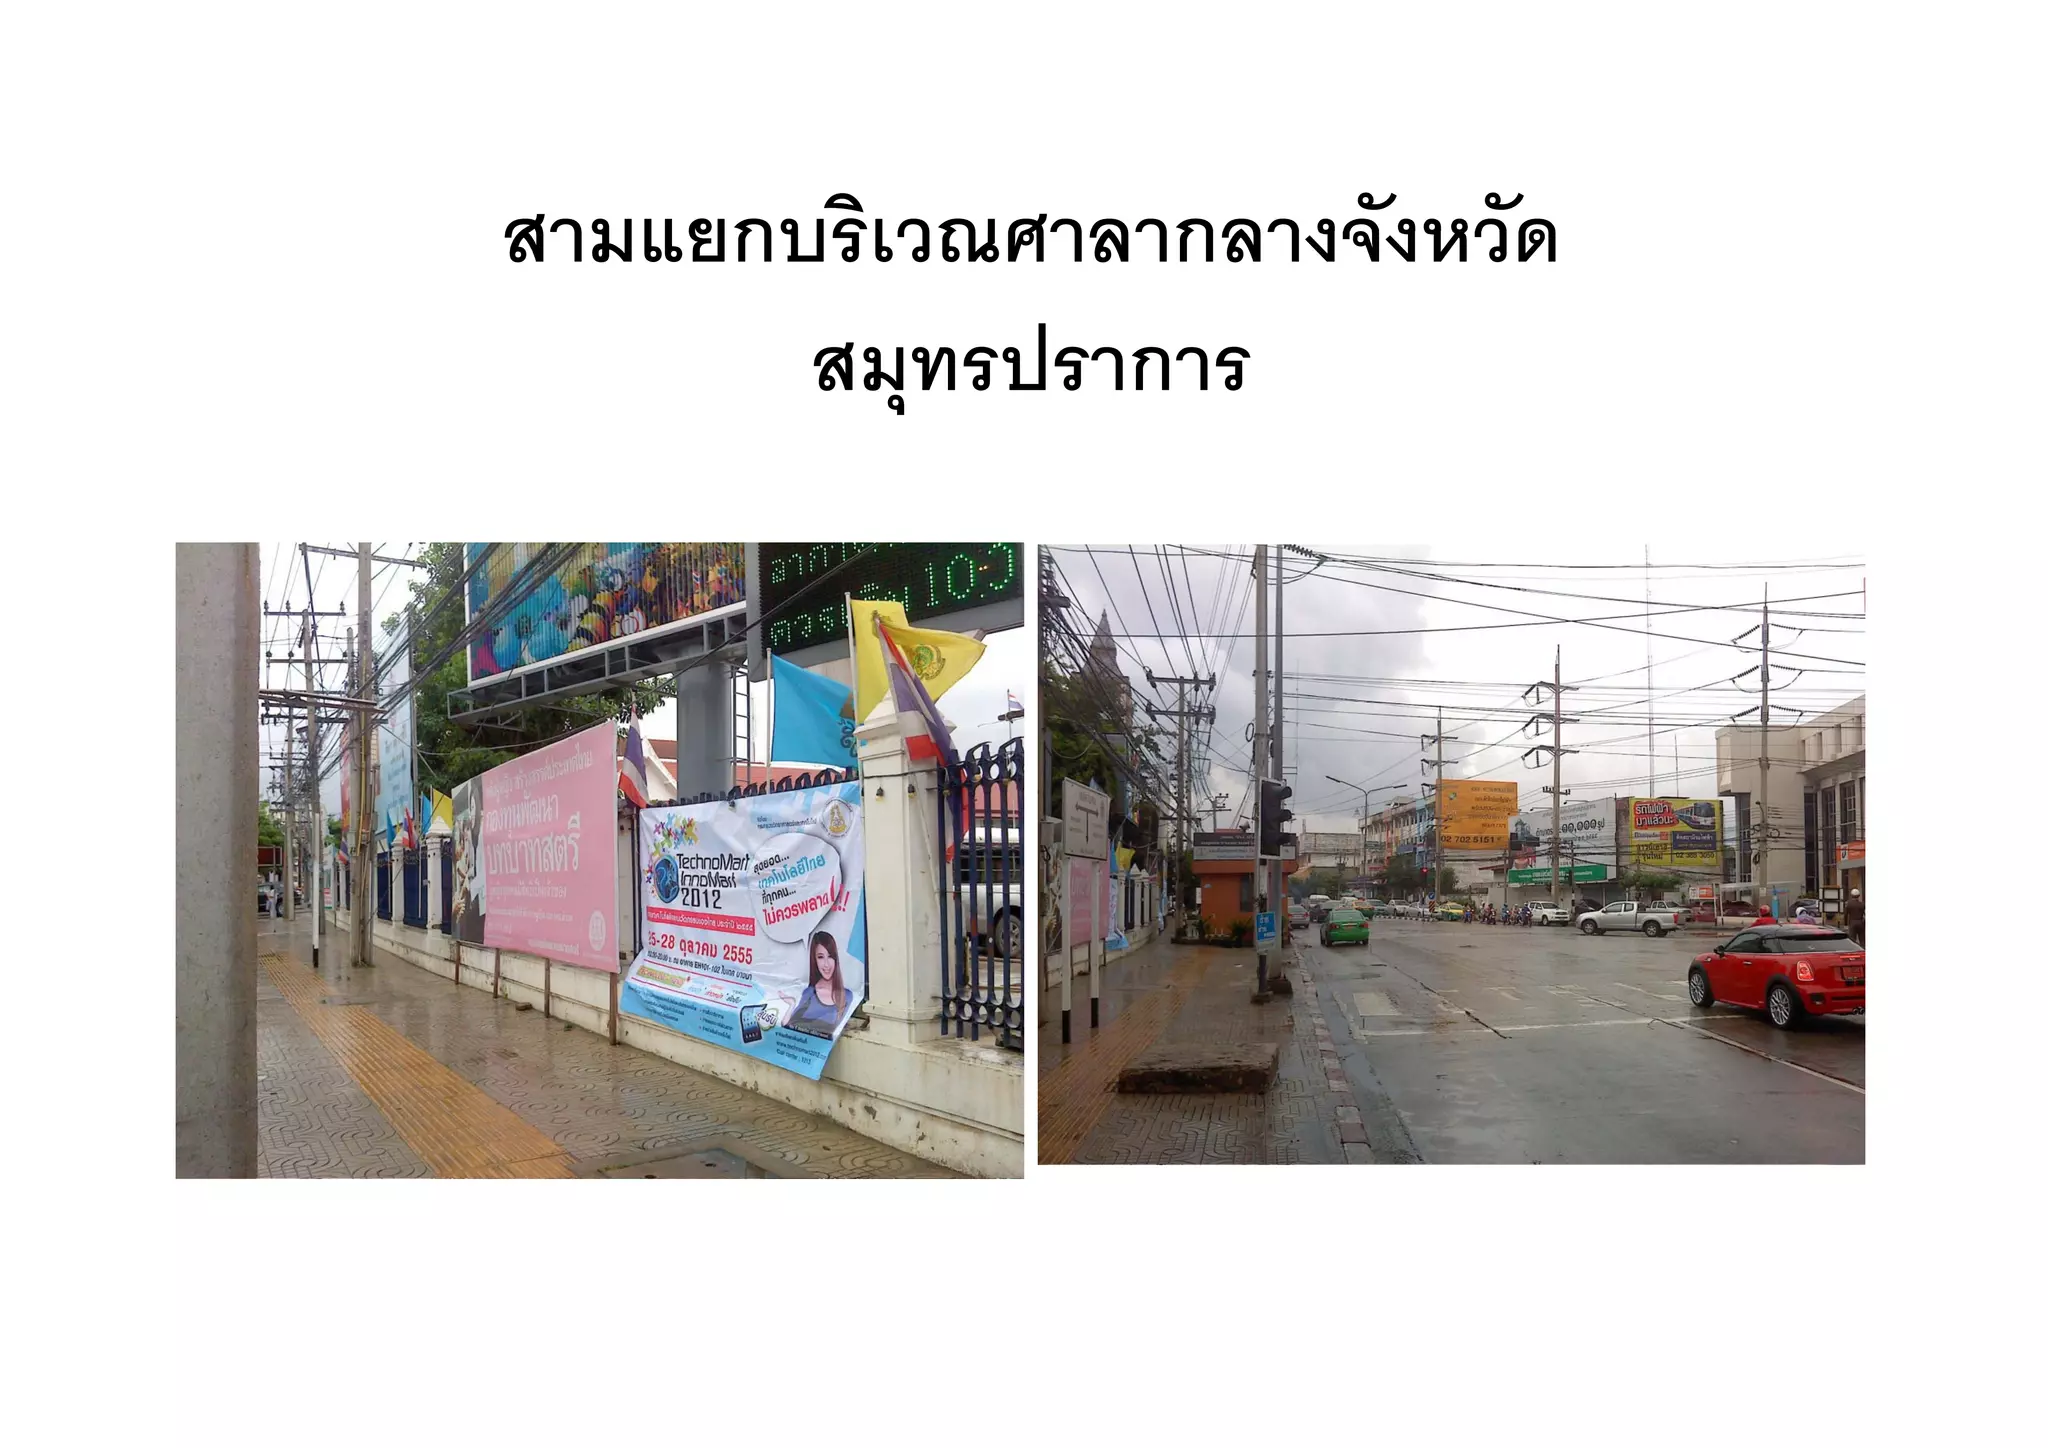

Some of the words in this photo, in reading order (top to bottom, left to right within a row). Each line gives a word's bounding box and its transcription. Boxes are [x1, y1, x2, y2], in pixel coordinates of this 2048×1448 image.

[1635, 803, 1669, 815] รถไฟฟ้า
[1636, 814, 1673, 827] มาแล้วนะ
[487, 811, 581, 875] บทบาทสตรี
[676, 853, 750, 872] TechnoMart
[753, 854, 790, 876] สุดยอด...
[758, 854, 827, 890] เทคโนโลยีไทย
[681, 870, 737, 888] InnoMart
[681, 887, 722, 909] 2012
[679, 938, 718, 958] ตุลาคม
[723, 943, 753, 966] 2555
